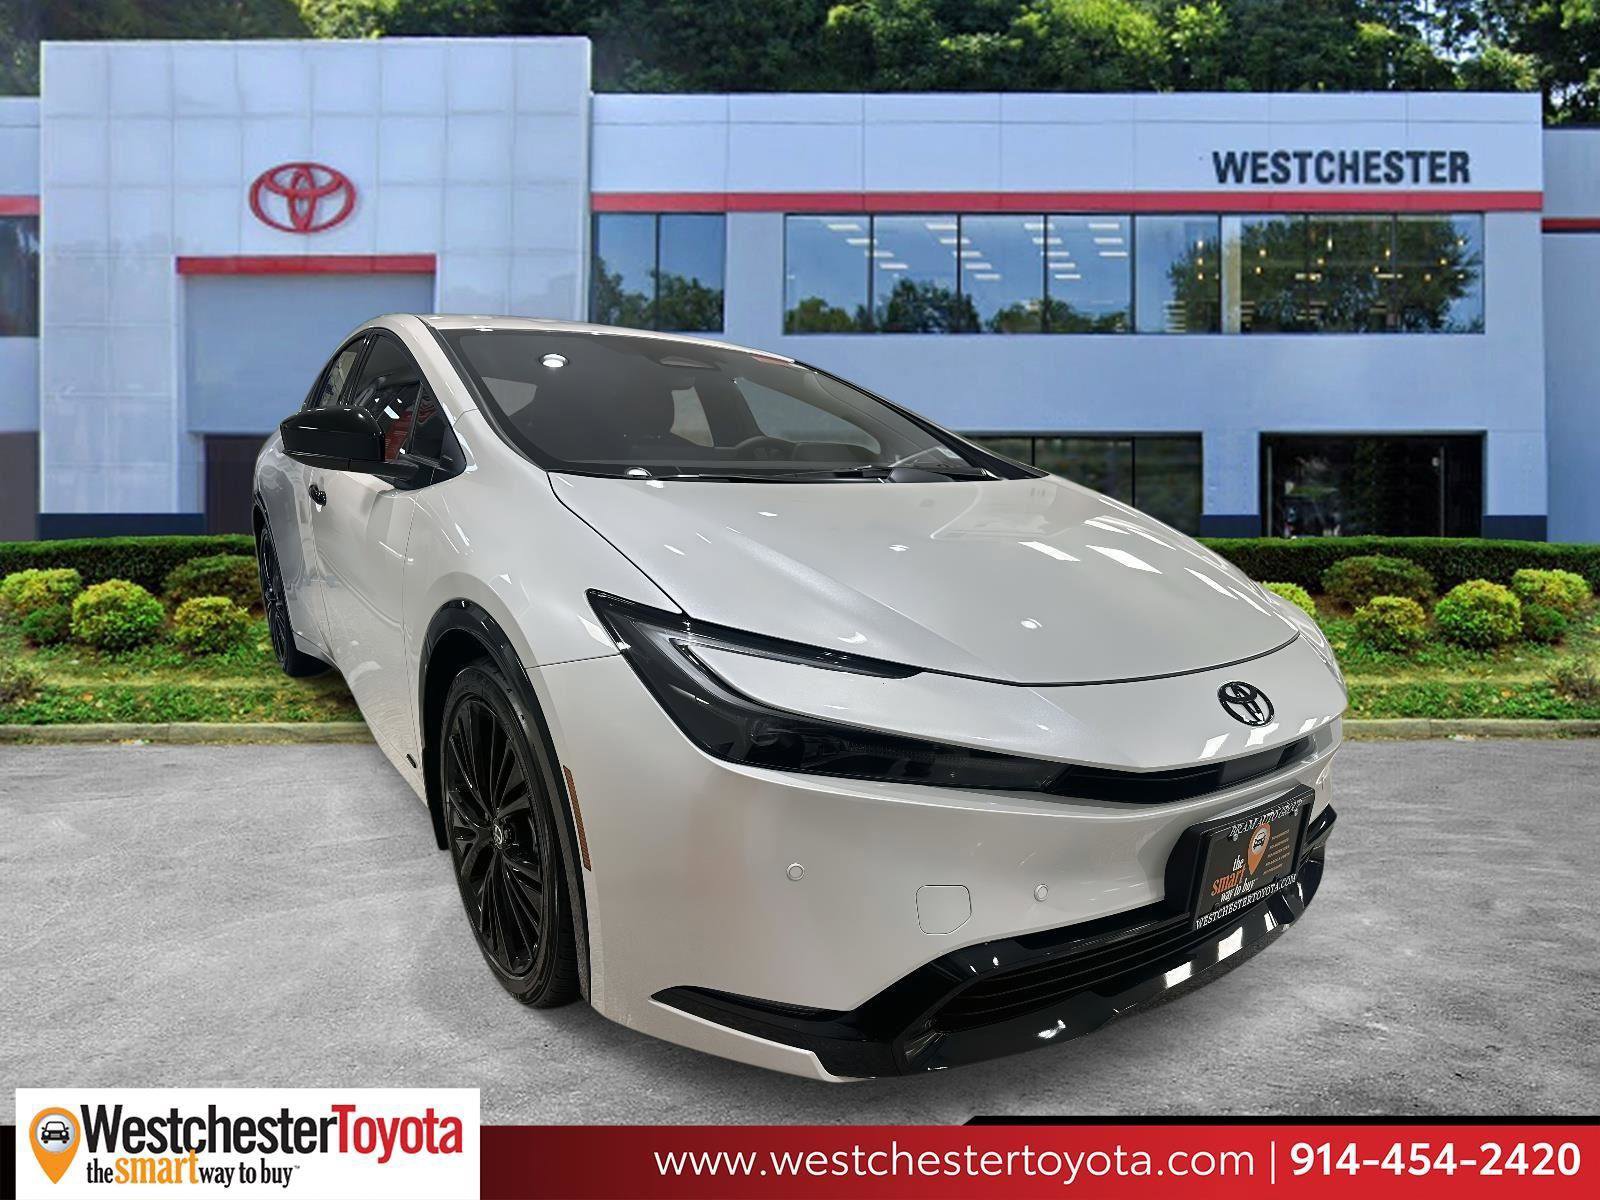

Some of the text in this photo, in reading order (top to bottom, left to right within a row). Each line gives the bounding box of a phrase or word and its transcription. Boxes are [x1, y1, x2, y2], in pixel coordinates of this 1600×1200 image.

[1212, 150, 1470, 185] WESTCHESTER
[1232, 854, 1245, 871] the
[1211, 863, 1247, 896] smart
[1220, 877, 1256, 903] way to buy
[1196, 873, 1297, 930] WESTCHESTERTOYOTA.COM
